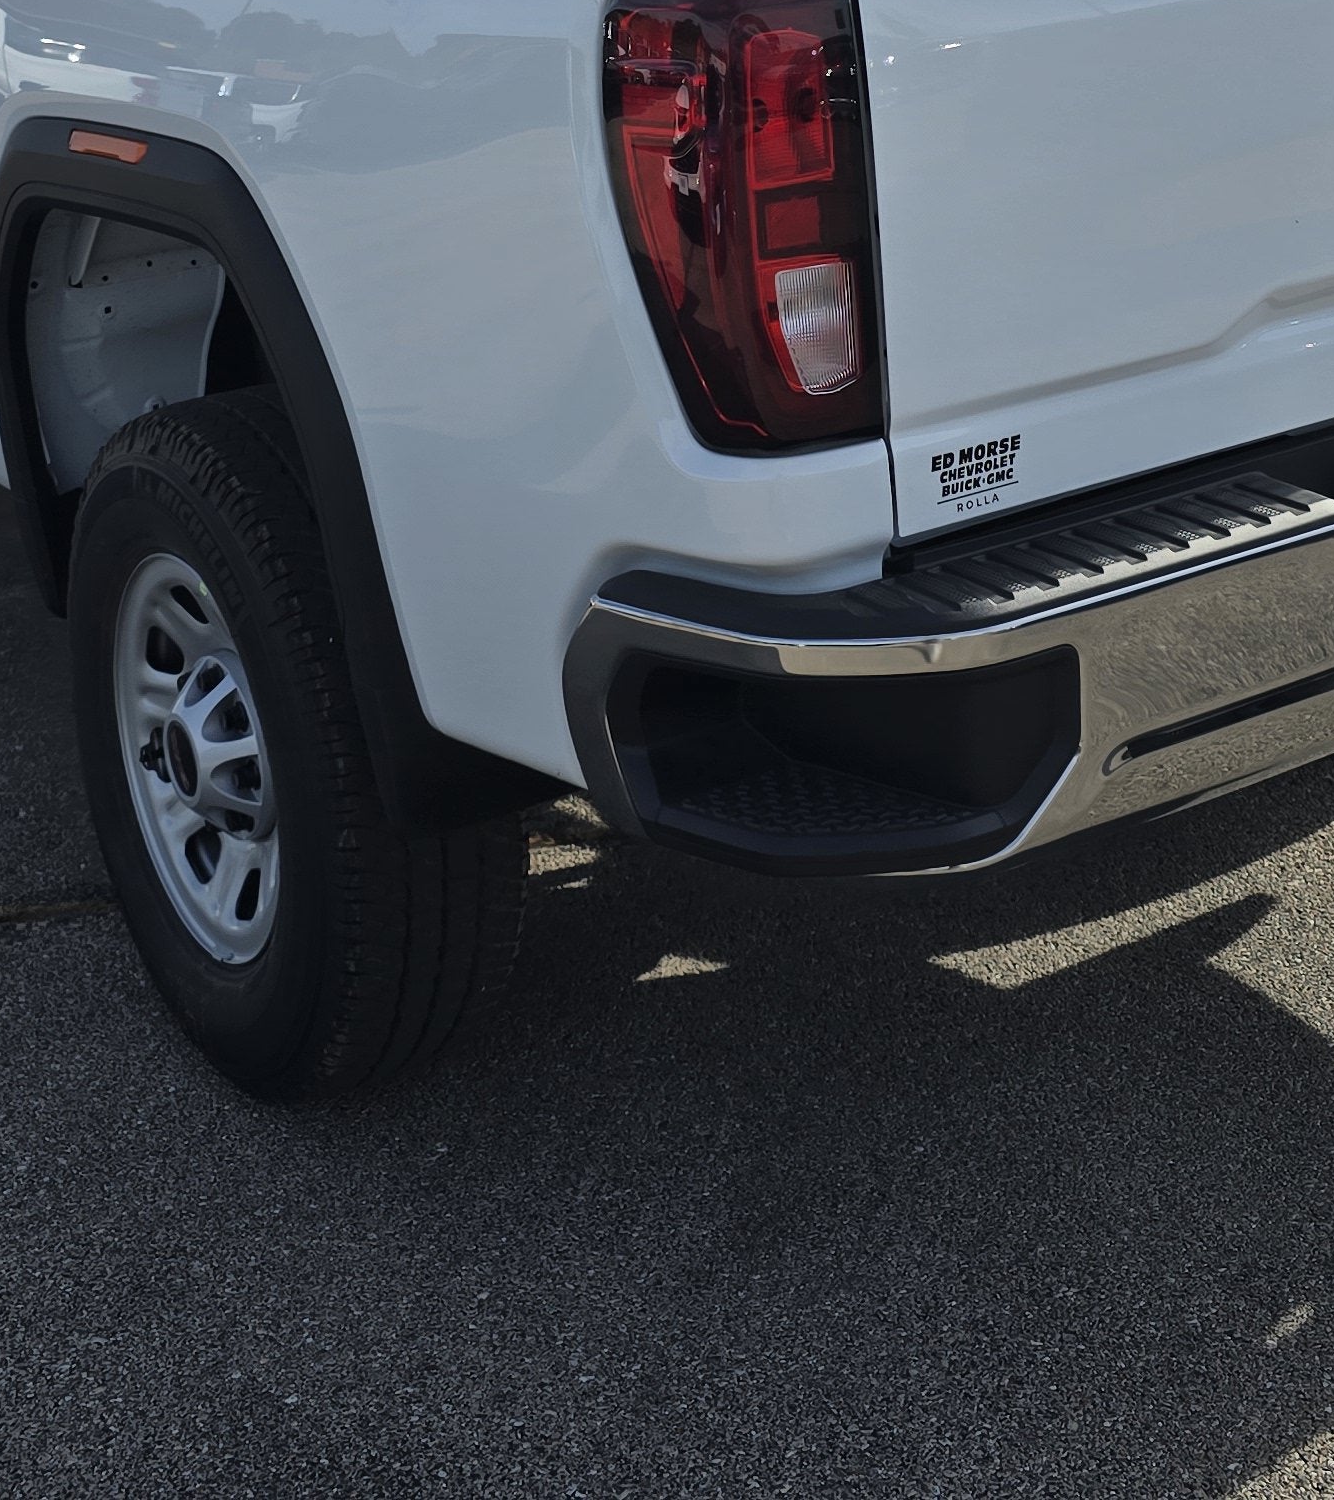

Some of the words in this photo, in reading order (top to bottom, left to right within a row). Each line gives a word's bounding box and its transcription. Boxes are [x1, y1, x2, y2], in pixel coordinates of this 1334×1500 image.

[931, 452, 955, 472] ED
[959, 434, 1021, 465] MORSE
[940, 453, 1016, 483] CHEVROLET
[957, 493, 1000, 512] ROLLA
